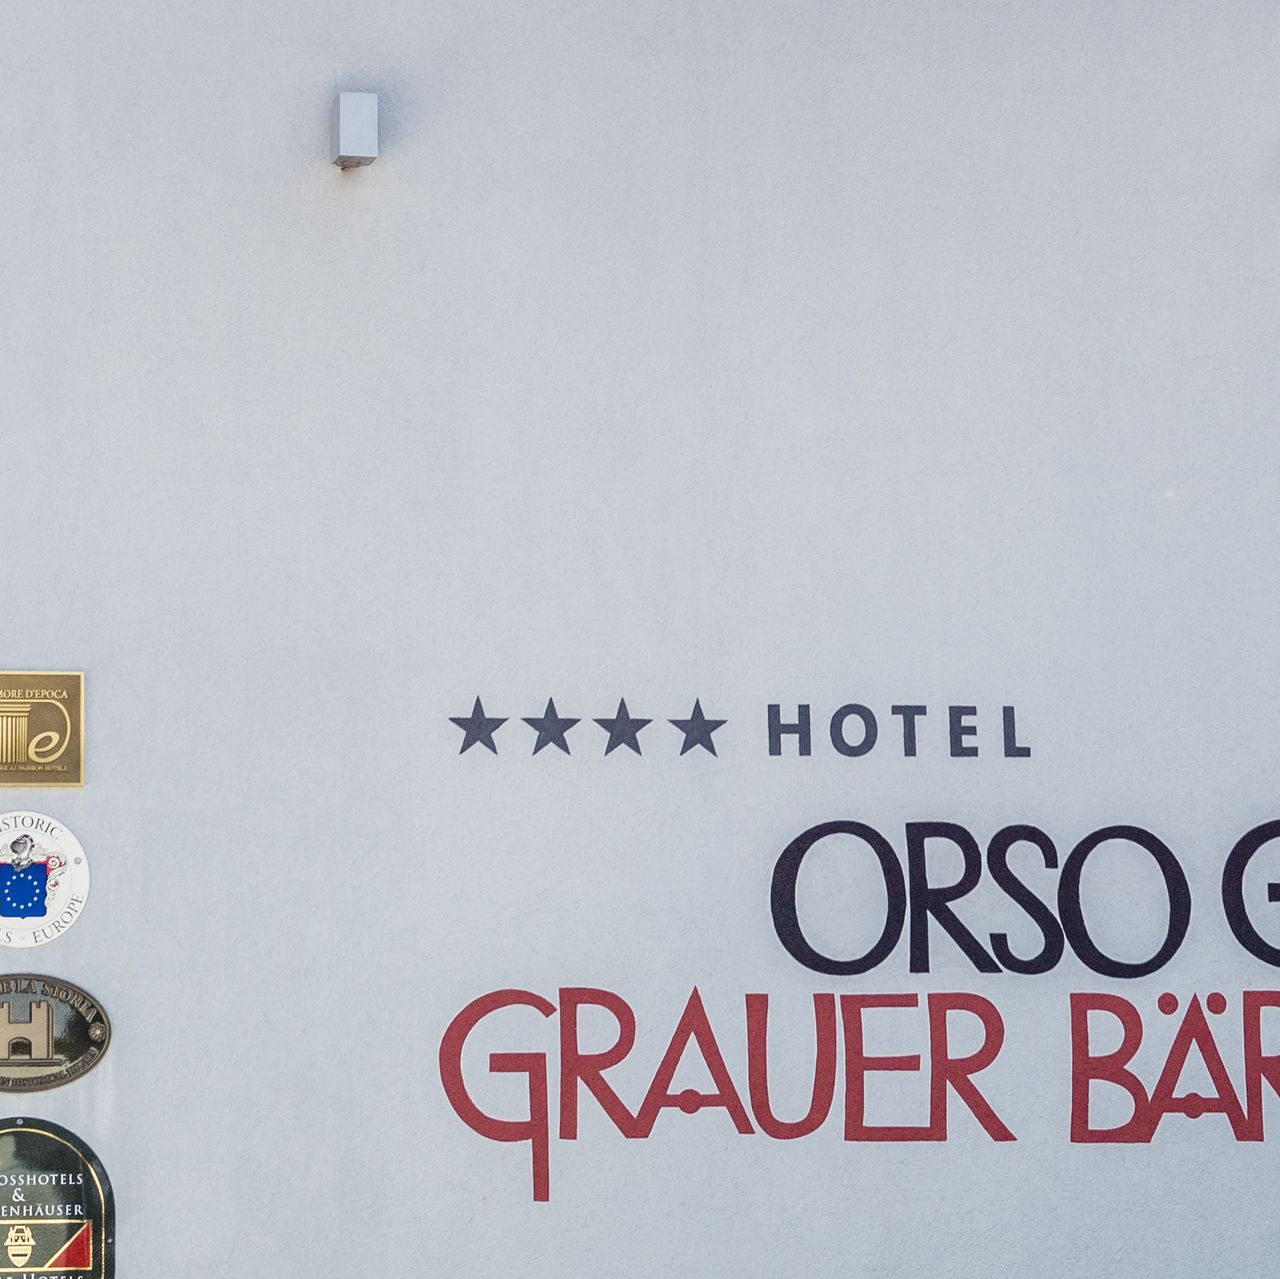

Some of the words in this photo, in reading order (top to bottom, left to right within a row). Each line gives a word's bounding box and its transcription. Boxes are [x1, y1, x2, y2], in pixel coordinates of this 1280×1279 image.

[25, 689, 68, 699] D'EPOCA
[768, 704, 1031, 757] HOTEL
[32, 893, 84, 944] EUROPE
[770, 820, 1191, 979] ORSO
[15, 979, 37, 993] LA
[42, 982, 98, 1023] STORIA
[439, 986, 1018, 1202] GRAUER
[12, 1188, 26, 1202] &
